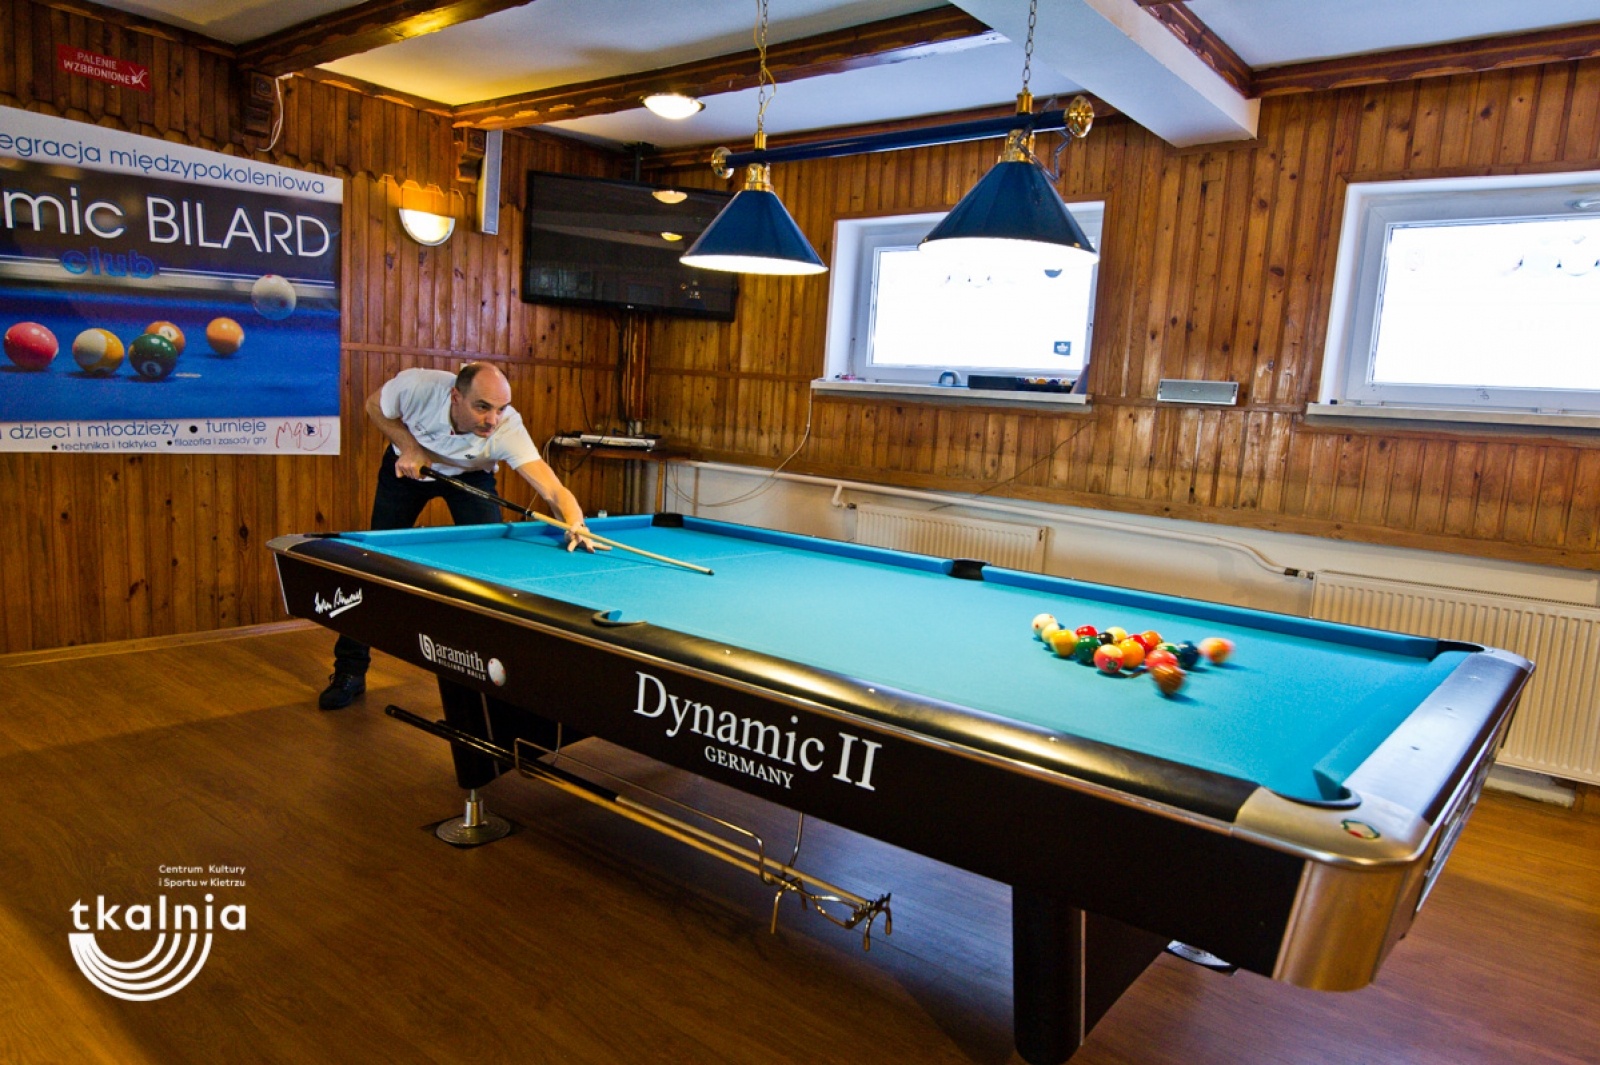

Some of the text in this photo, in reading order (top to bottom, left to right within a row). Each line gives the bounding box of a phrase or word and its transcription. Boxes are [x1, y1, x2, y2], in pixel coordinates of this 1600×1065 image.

[63, 59, 131, 85] WZBRONIONE
[76, 51, 117, 70] PALENIE
[0, 133, 325, 194] egracja międzypokoleniowa
[3, 187, 331, 257] mic BILARD
[59, 246, 156, 280] club
[9, 423, 70, 440] dzieci
[87, 420, 179, 437] młodzieży
[205, 418, 267, 435] turnieje
[60, 441, 110, 451] technika
[118, 439, 157, 449] taktyka
[174, 437, 212, 447] filozofia
[218, 436, 250, 446] zasady
[253, 435, 268, 445] gry
[633, 671, 882, 791] Dynamic II
[704, 745, 794, 789] GERMANY
